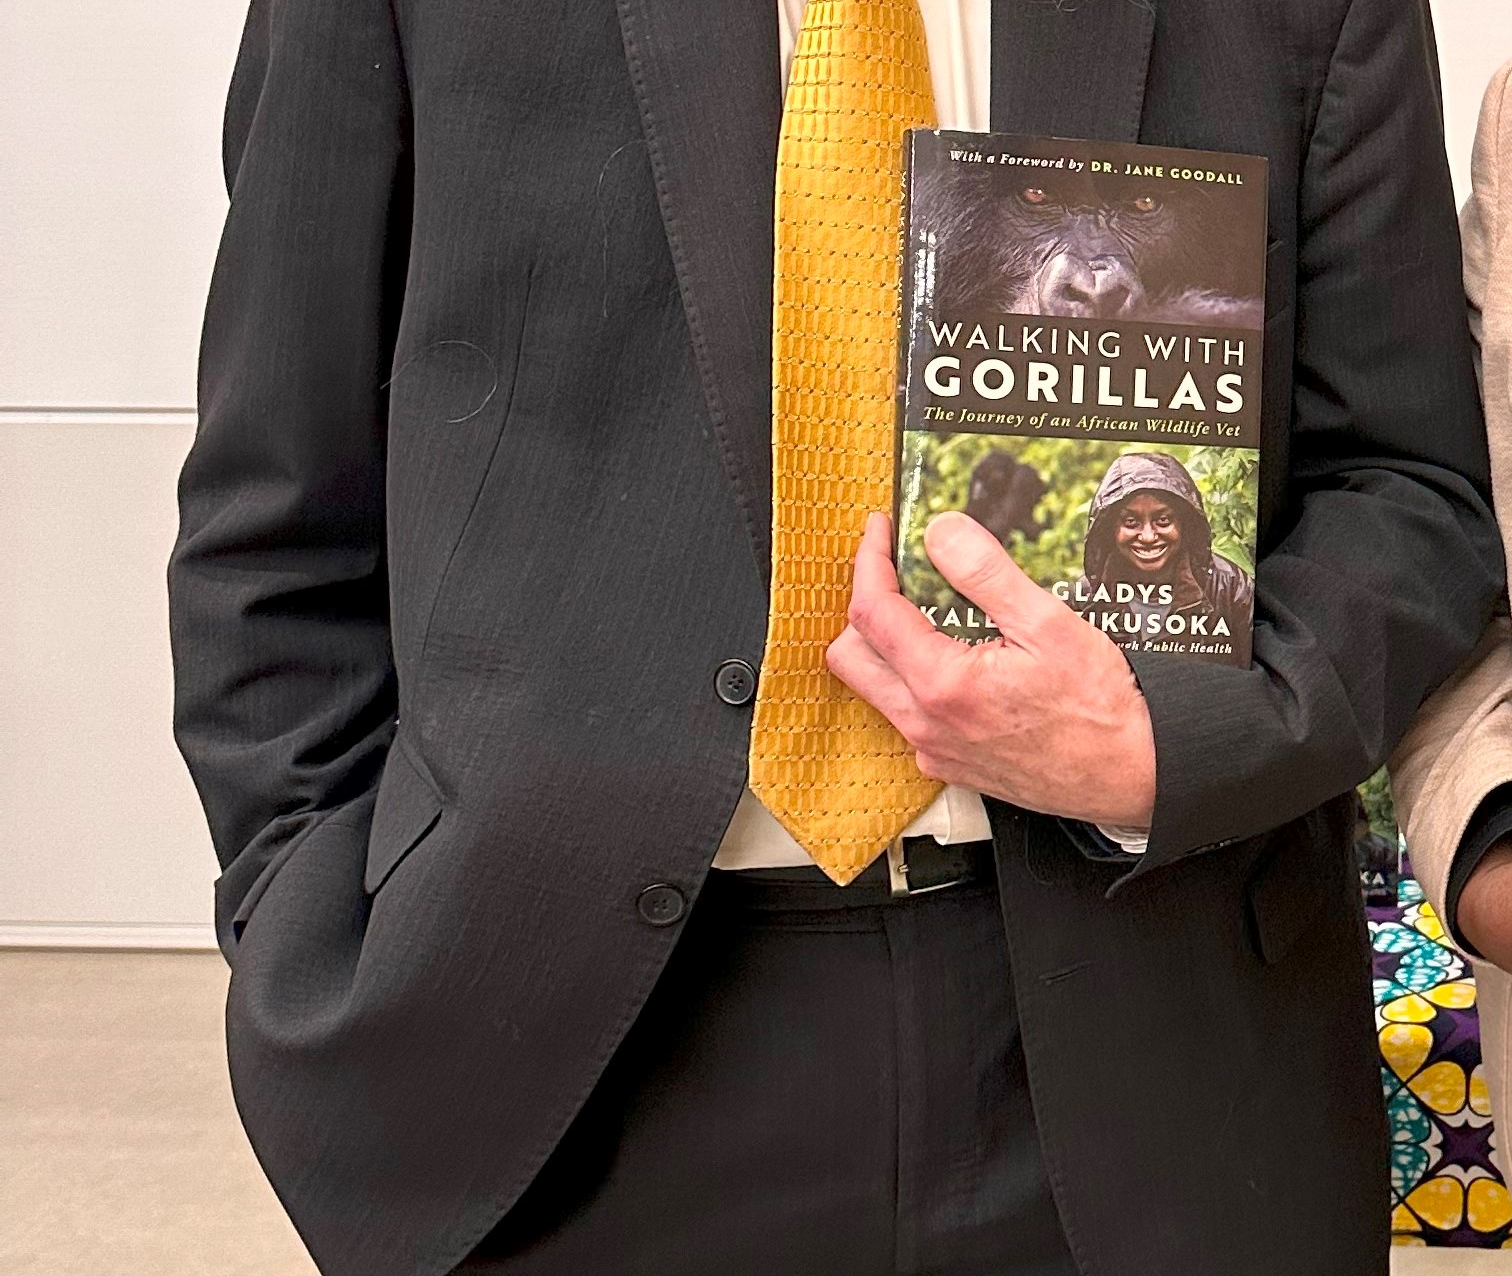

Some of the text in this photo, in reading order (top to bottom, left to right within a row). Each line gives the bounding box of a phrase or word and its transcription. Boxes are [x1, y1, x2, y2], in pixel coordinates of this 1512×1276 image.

[950, 150, 1244, 185] With a Foreword by DR. JANE GOODALL
[928, 320, 1245, 366] WALKING WITH
[924, 356, 1244, 414] GORILLAS
[923, 406, 1241, 438] The Journey of an African Wildlife Vet
[1051, 581, 1173, 605] GLADYS
[1143, 641, 1186, 653] Public
[1190, 642, 1232, 654] Health
